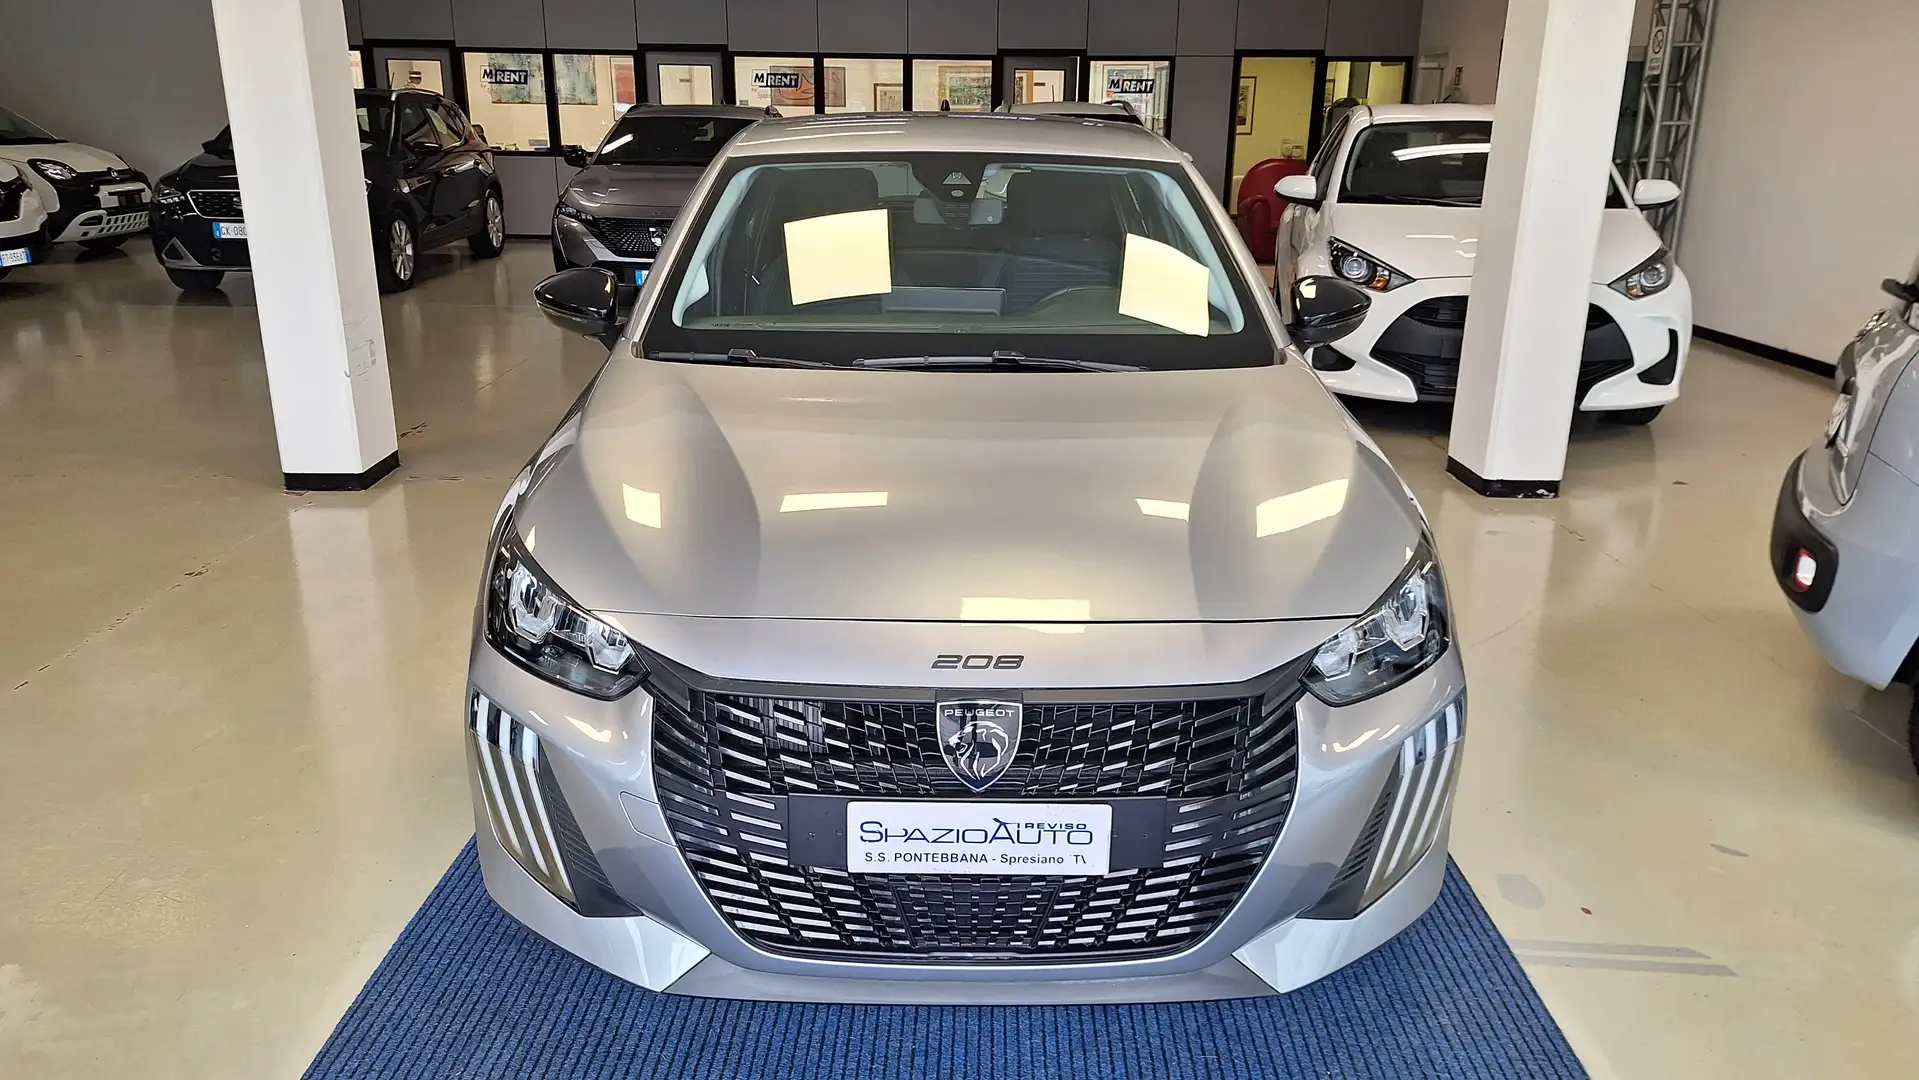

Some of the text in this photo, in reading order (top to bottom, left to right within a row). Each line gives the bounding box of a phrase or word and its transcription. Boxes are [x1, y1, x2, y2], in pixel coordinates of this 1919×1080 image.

[496, 71, 526, 83] RENT
[767, 75, 798, 87] RENT
[1122, 81, 1153, 92] RENT
[931, 654, 1024, 669] 208
[944, 707, 1015, 717] PEUGEOT
[864, 852, 891, 863] S.S.
[894, 852, 988, 863] PONTEBBANA
[1000, 853, 1064, 866] Spresiano
